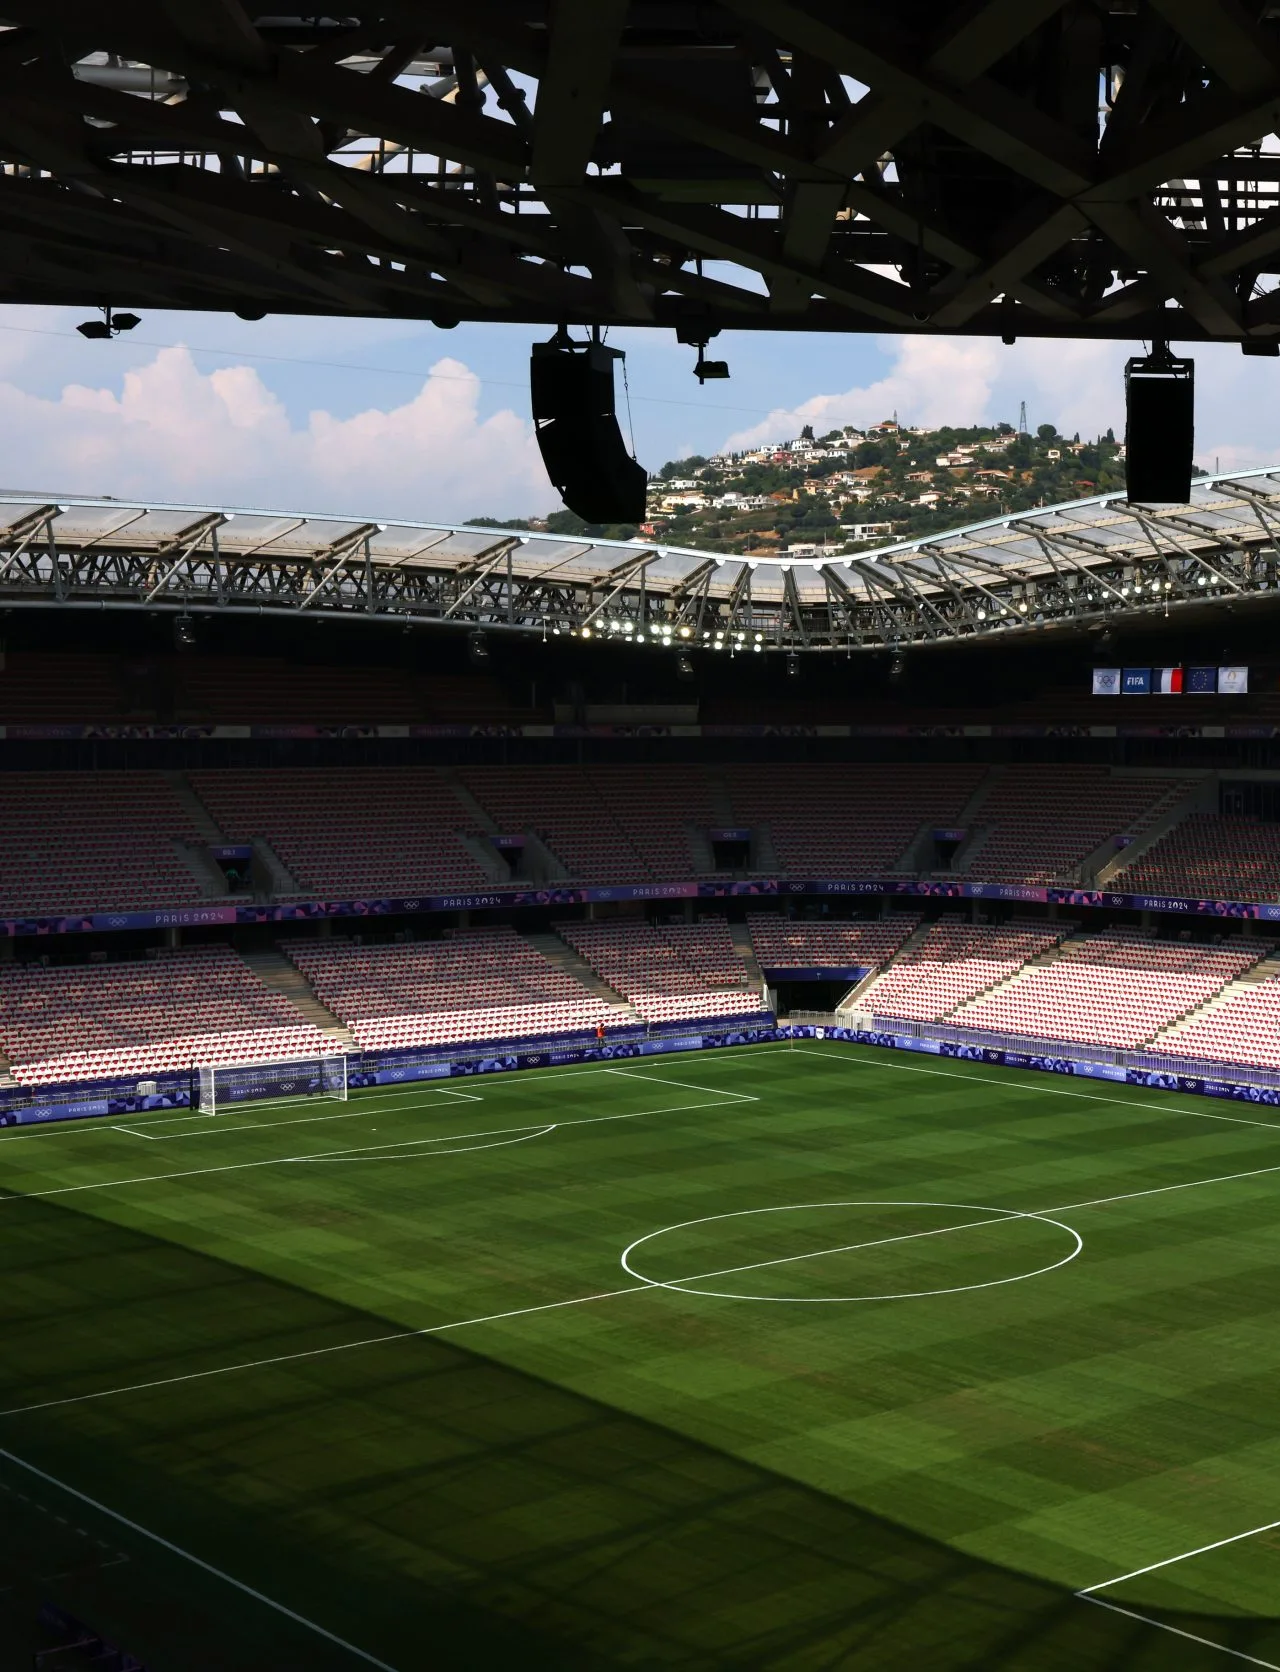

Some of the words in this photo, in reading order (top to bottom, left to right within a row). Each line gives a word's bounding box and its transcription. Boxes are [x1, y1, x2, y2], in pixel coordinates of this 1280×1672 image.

[1127, 677, 1144, 686] FIFA
[661, 887, 688, 895] 2024
[858, 884, 884, 892] 2024
[1022, 890, 1043, 898] 2024
[473, 897, 501, 906] 2024
[1168, 900, 1188, 910] 2024
[194, 911, 224, 921] 2024
